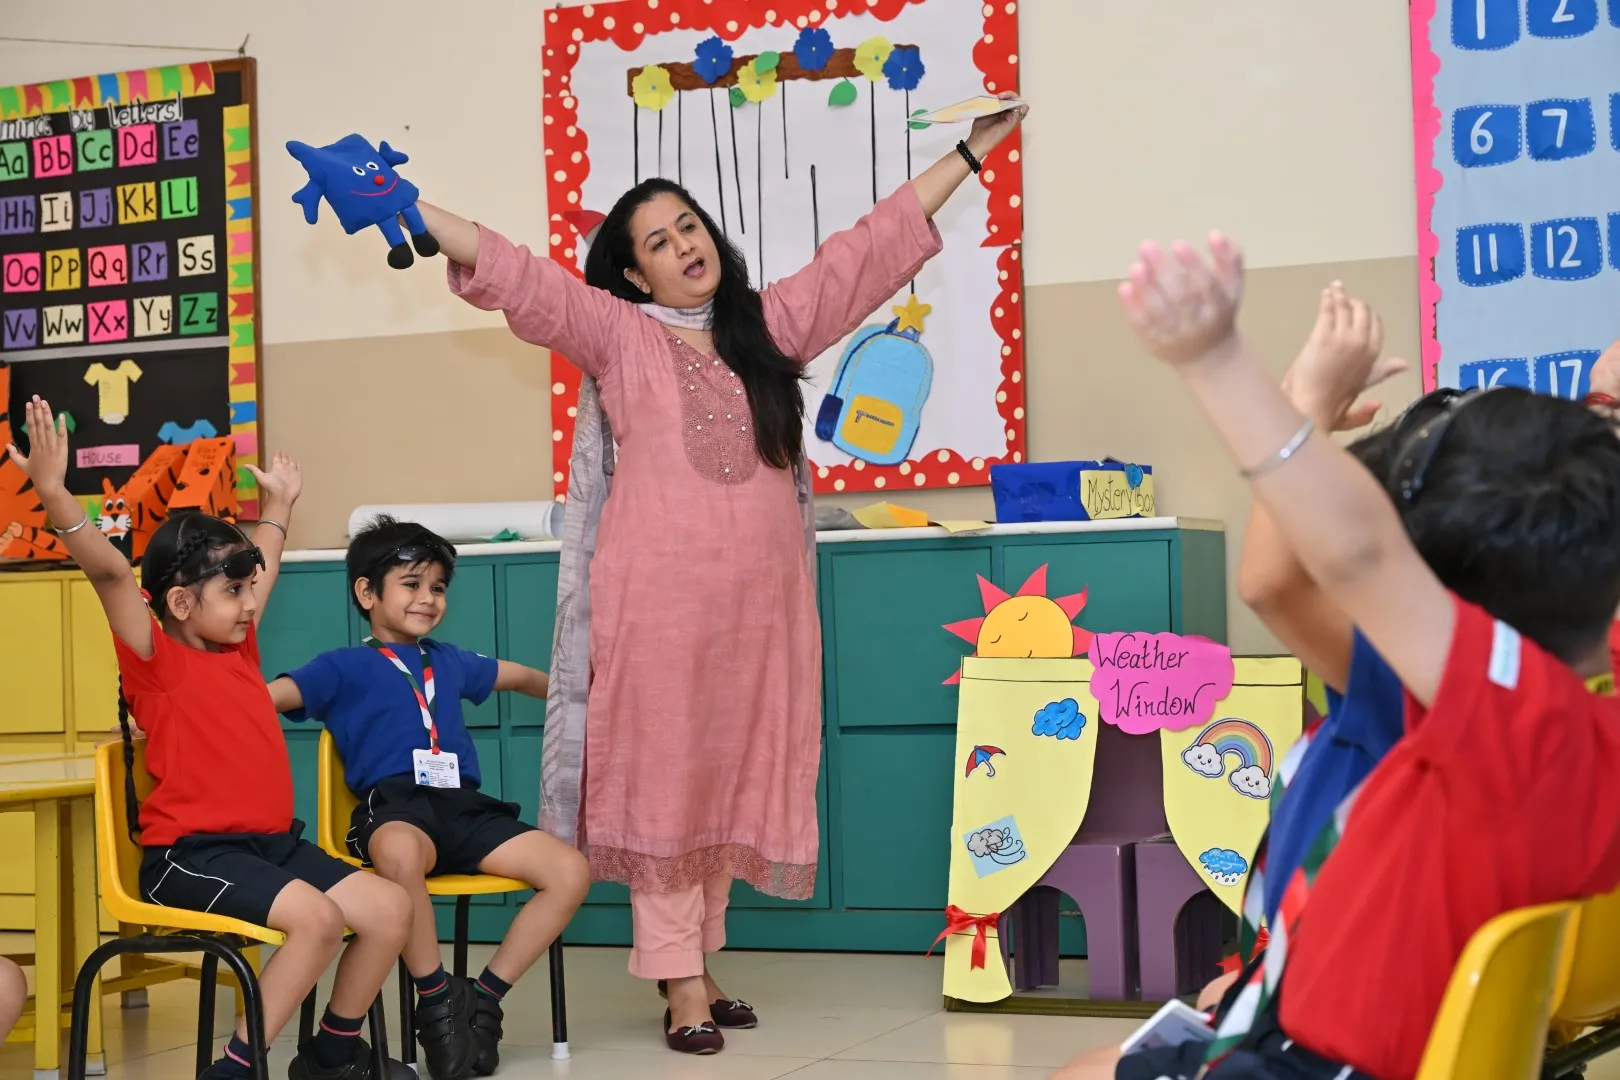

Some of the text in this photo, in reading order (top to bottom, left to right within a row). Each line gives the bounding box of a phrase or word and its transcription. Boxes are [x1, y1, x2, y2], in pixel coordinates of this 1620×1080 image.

[67, 103, 96, 132] by
[1470, 108, 1568, 155] 6 7
[40, 141, 71, 172] Bb
[82, 137, 111, 164] Cc
[123, 130, 154, 161] Dd
[168, 126, 198, 157] Ee
[4, 180, 197, 230] Hh Ii Jj Kk Ll
[6, 242, 213, 288] Oo Pp Qq Rr Ss
[1472, 225, 1582, 276] 11 12
[5, 297, 217, 342] Vv Ww Xx Yy Zz
[1550, 358, 1582, 401] 17
[82, 451, 122, 465] HOUSE
[1087, 477, 1132, 517] Mystery
[1096, 634, 1189, 671] Weather
[1110, 678, 1216, 719] Window
